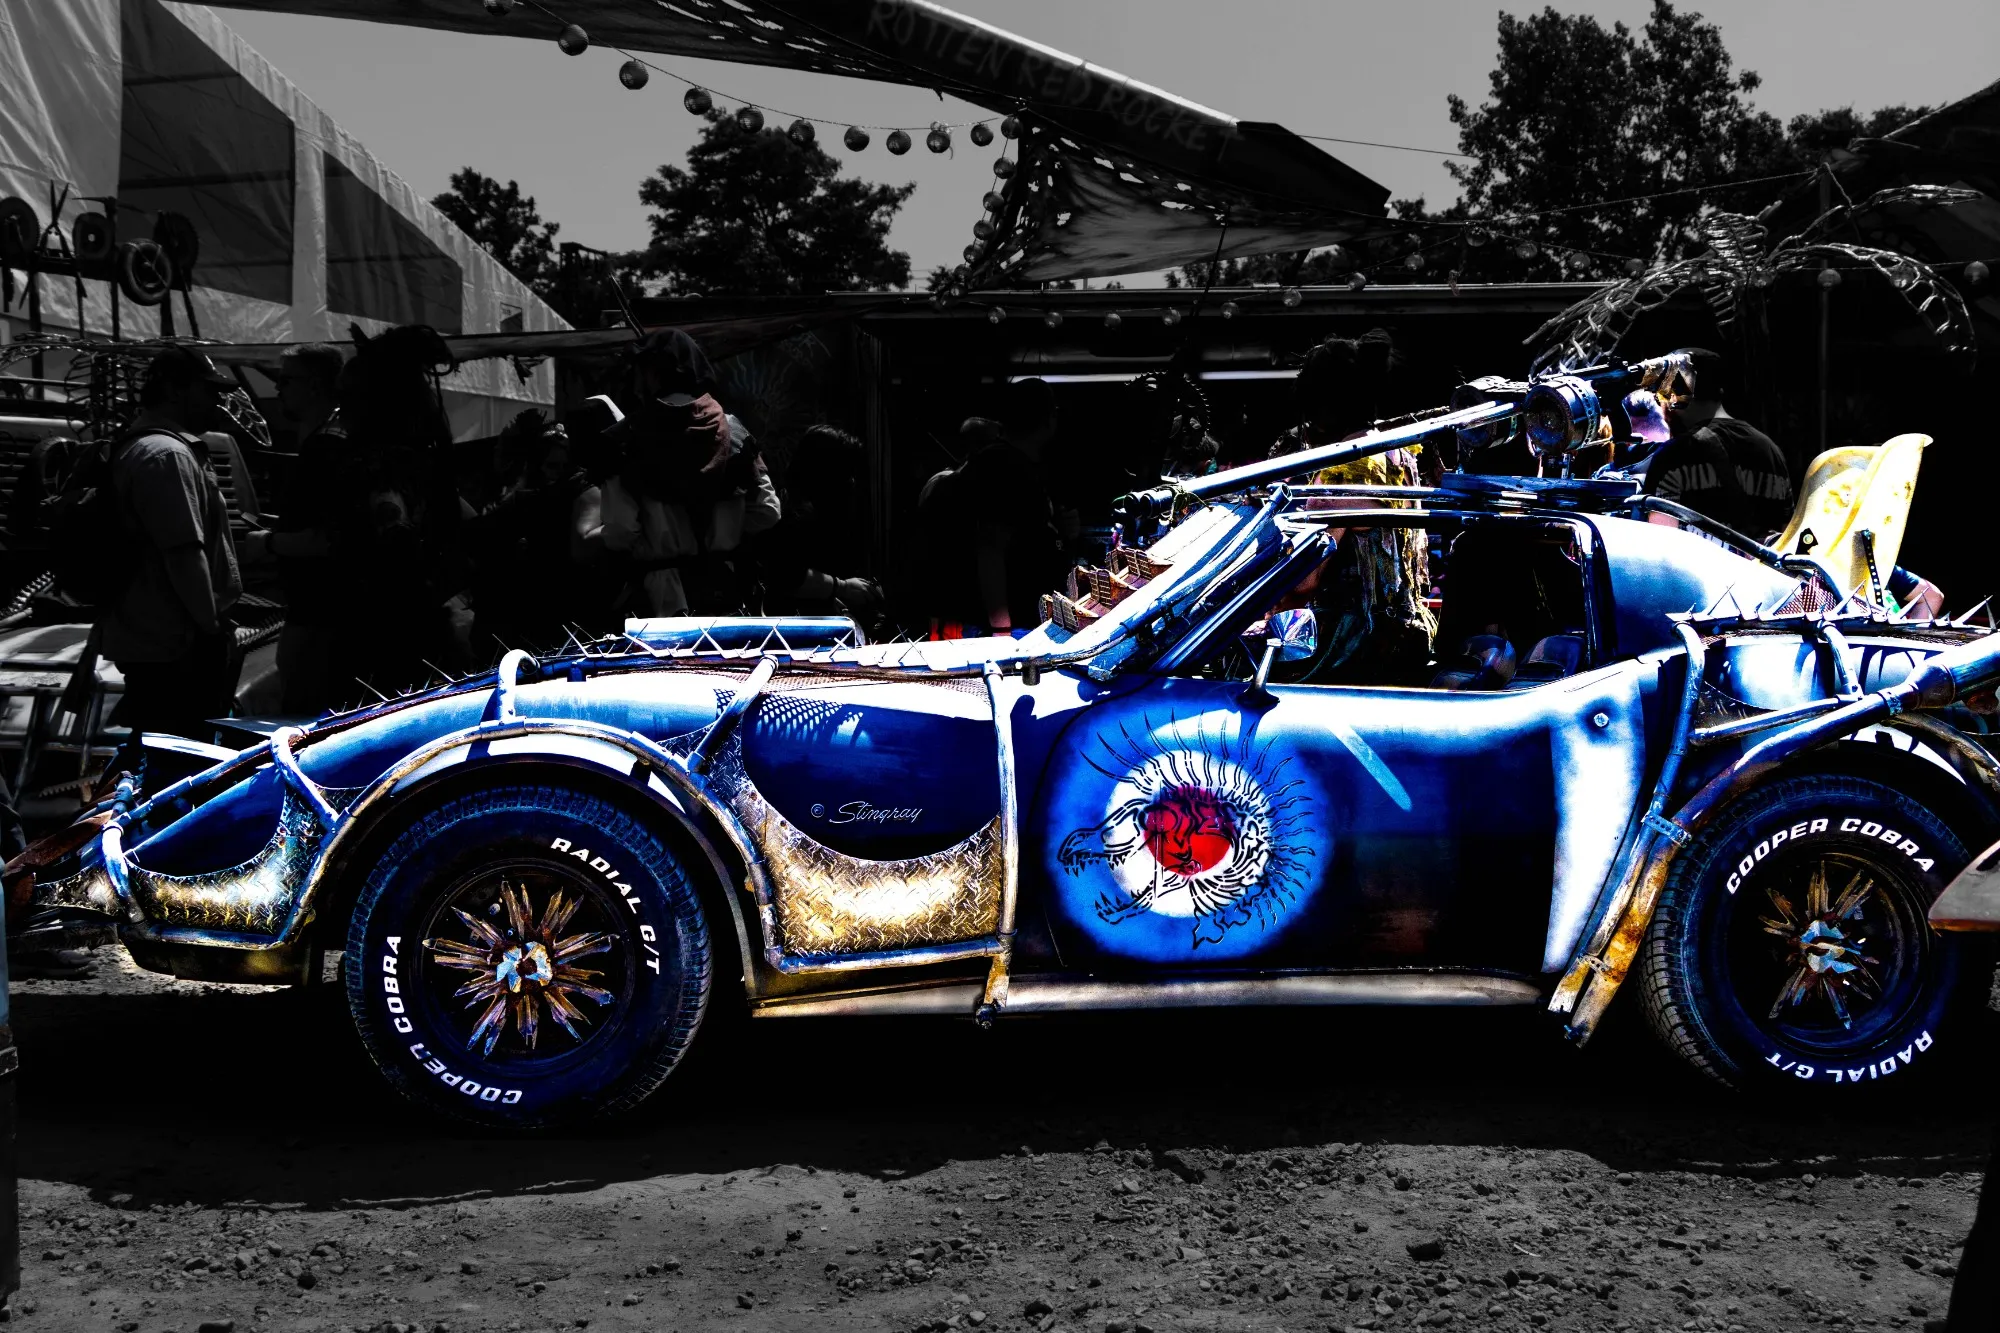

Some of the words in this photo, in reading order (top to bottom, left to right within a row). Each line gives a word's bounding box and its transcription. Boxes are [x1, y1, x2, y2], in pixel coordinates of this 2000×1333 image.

[867, 2, 1012, 80] ROTTEN
[1017, 50, 1091, 106] RED
[1099, 87, 1246, 163] ROCKET
[829, 800, 923, 824] Stingray
[1726, 818, 1829, 895] COOPER
[1839, 818, 1935, 872] COBRA
[550, 837, 642, 914] RADIAL
[639, 924, 660, 975] G/T
[382, 936, 413, 1034] COBRA
[1765, 1052, 1815, 1079] G/T
[1826, 1030, 1933, 1083] RADIAL
